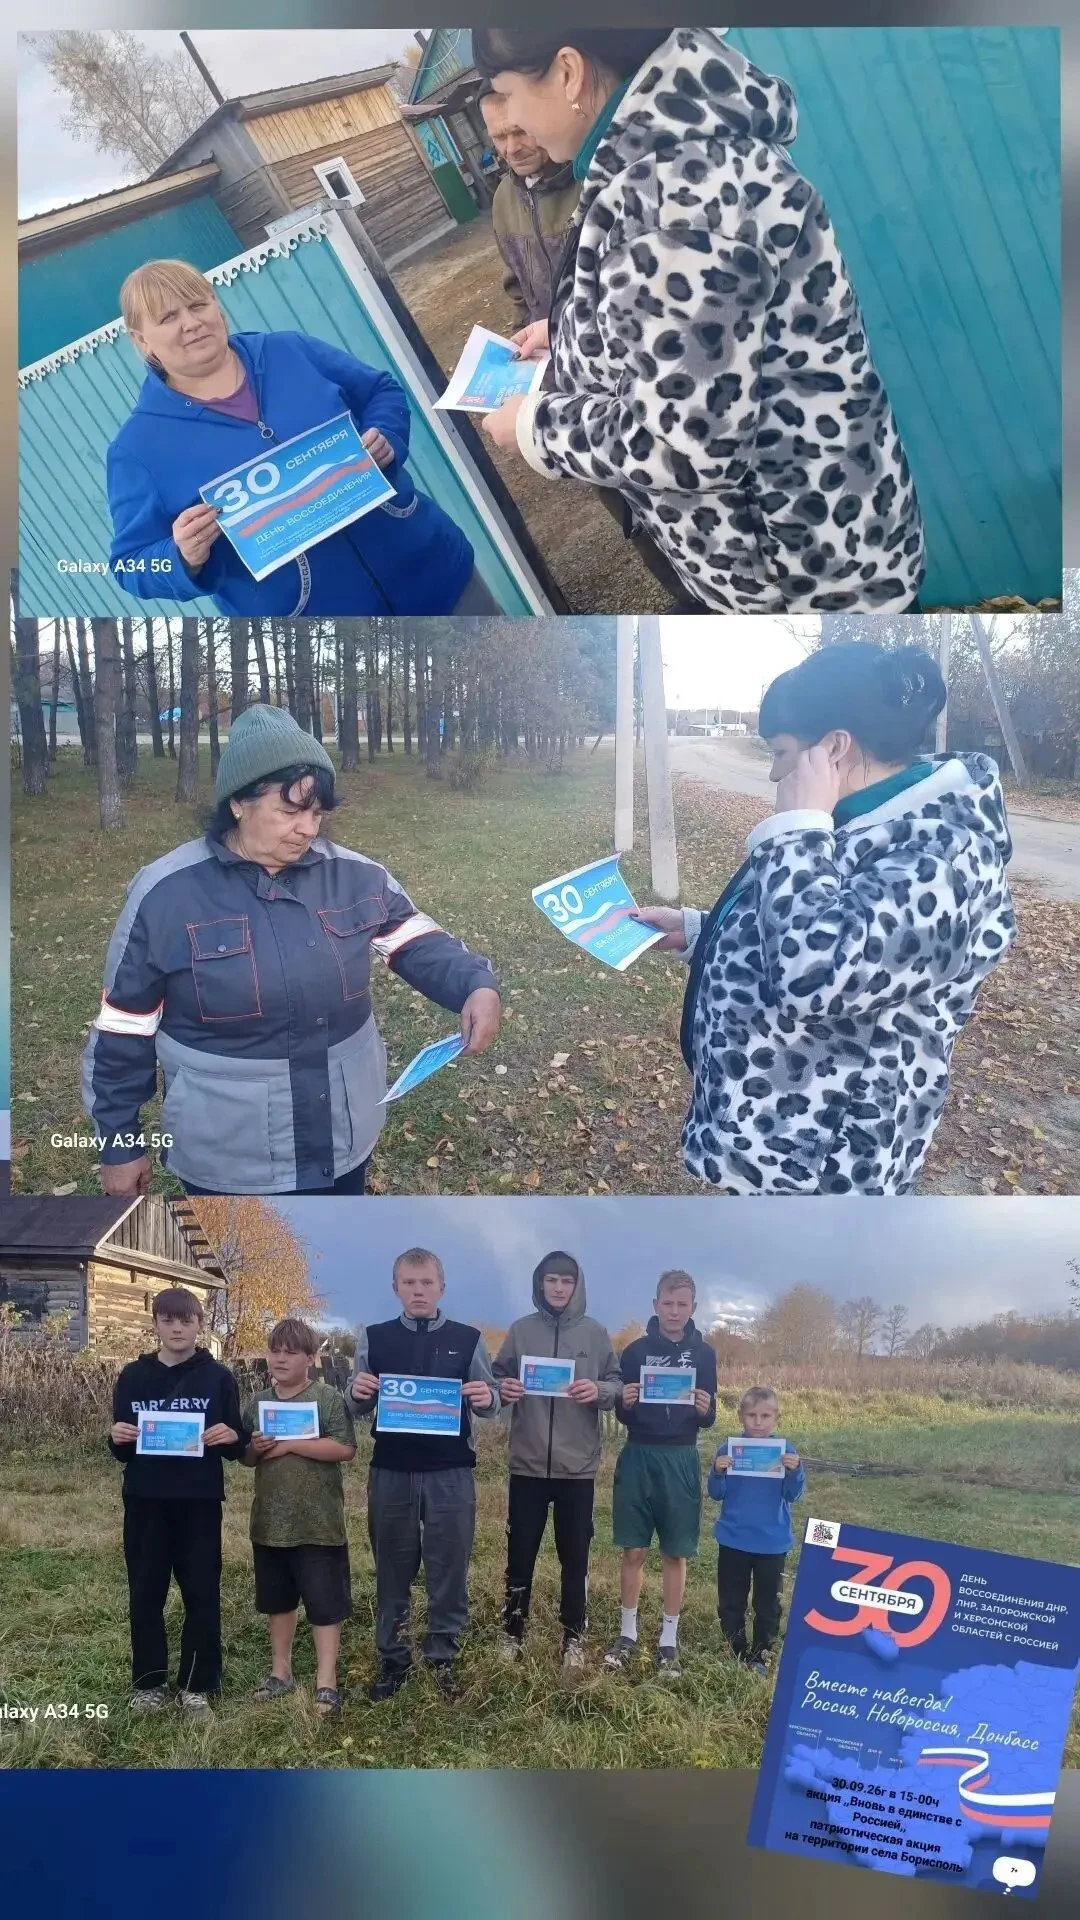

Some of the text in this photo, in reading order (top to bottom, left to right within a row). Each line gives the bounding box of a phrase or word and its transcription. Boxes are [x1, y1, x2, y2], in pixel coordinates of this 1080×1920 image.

[213, 461, 281, 513] 30
[285, 429, 349, 470] СЕНТЯБРЯ
[255, 525, 286, 545] ДЕНЬ
[286, 471, 372, 527] ВОССОЕДИНЕНИЯ
[542, 875, 618, 923] 30 СЕНТЯБРЯ
[383, 1379, 458, 1397] 30 СЕНТЯБРЯ
[960, 1574, 987, 1585] ДЕНЬ
[804, 1547, 951, 1647] 30
[839, 1586, 917, 1610] СЕНТЯБРЯ
[956, 1599, 1056, 1624] ЛНР, ЗАПОРОЖСКОЙ
[958, 1586, 1069, 1614] ВОССОЕДИНЕНИЯ ДНР,
[951, 1624, 1059, 1651] ОБЛАСТЕЙ С РОССИЕЙ
[963, 1613, 1028, 1632] ХЕРСОНСКОЙ
[805, 1670, 954, 1712] Вместе навсегда!
[801, 1691, 1040, 1750] Россия, Новороссия, Донбасс
[806, 1789, 841, 1803] акция
[888, 1805, 895, 1814] в
[898, 1807, 953, 1825] единстве
[955, 1818, 962, 1827] с
[832, 1777, 940, 1807] 30.09.26г в 15-00ч
[785, 1831, 964, 1873] на территории села Борисполь
[810, 1820, 941, 1853] патриотическая акция
